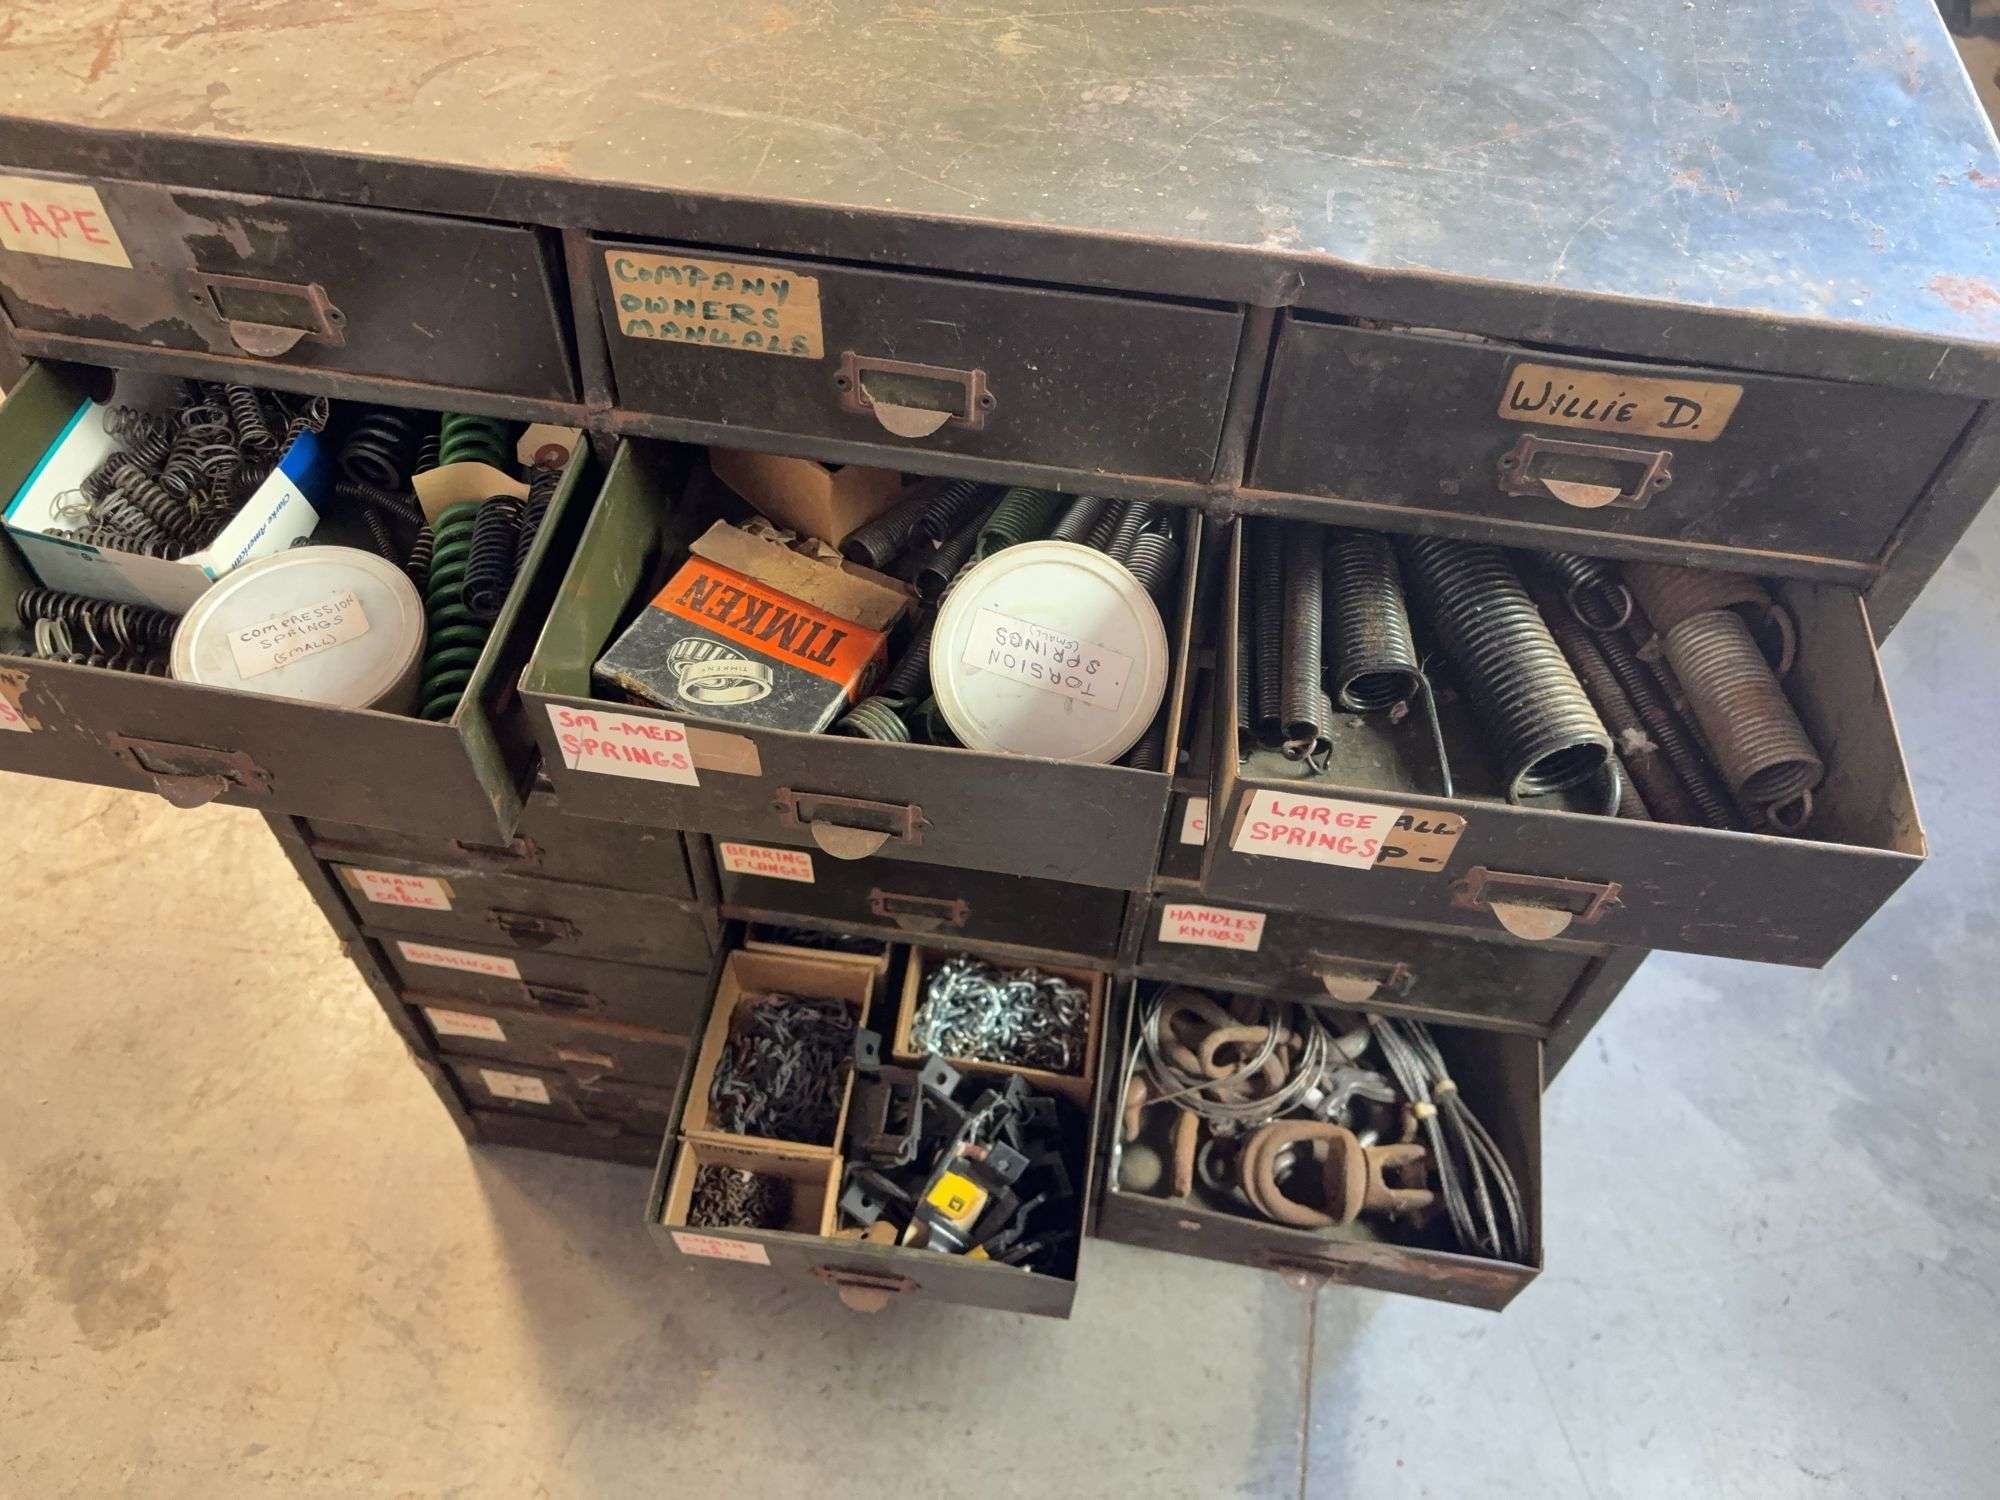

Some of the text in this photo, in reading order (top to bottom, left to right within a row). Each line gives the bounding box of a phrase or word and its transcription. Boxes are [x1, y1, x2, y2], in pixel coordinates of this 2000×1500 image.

[0, 200, 111, 245] TAPE
[620, 293, 780, 329] OWNERS
[1656, 395, 1703, 430] D.
[267, 493, 290, 525] Clarke
[259, 615, 344, 649] SPRINGS
[675, 574, 848, 667] TIMKEN
[273, 634, 337, 664] (SMALL)
[995, 627, 1101, 675] SPRINGS
[988, 650, 1096, 697] TORSION
[561, 733, 690, 771] SPRINGS
[1271, 801, 1378, 829] LARGE
[725, 844, 809, 866] BEARING
[1249, 821, 1378, 858] SPRINGS
[1169, 909, 1259, 932] HANDLES
[1178, 924, 1246, 944] KNOBS
